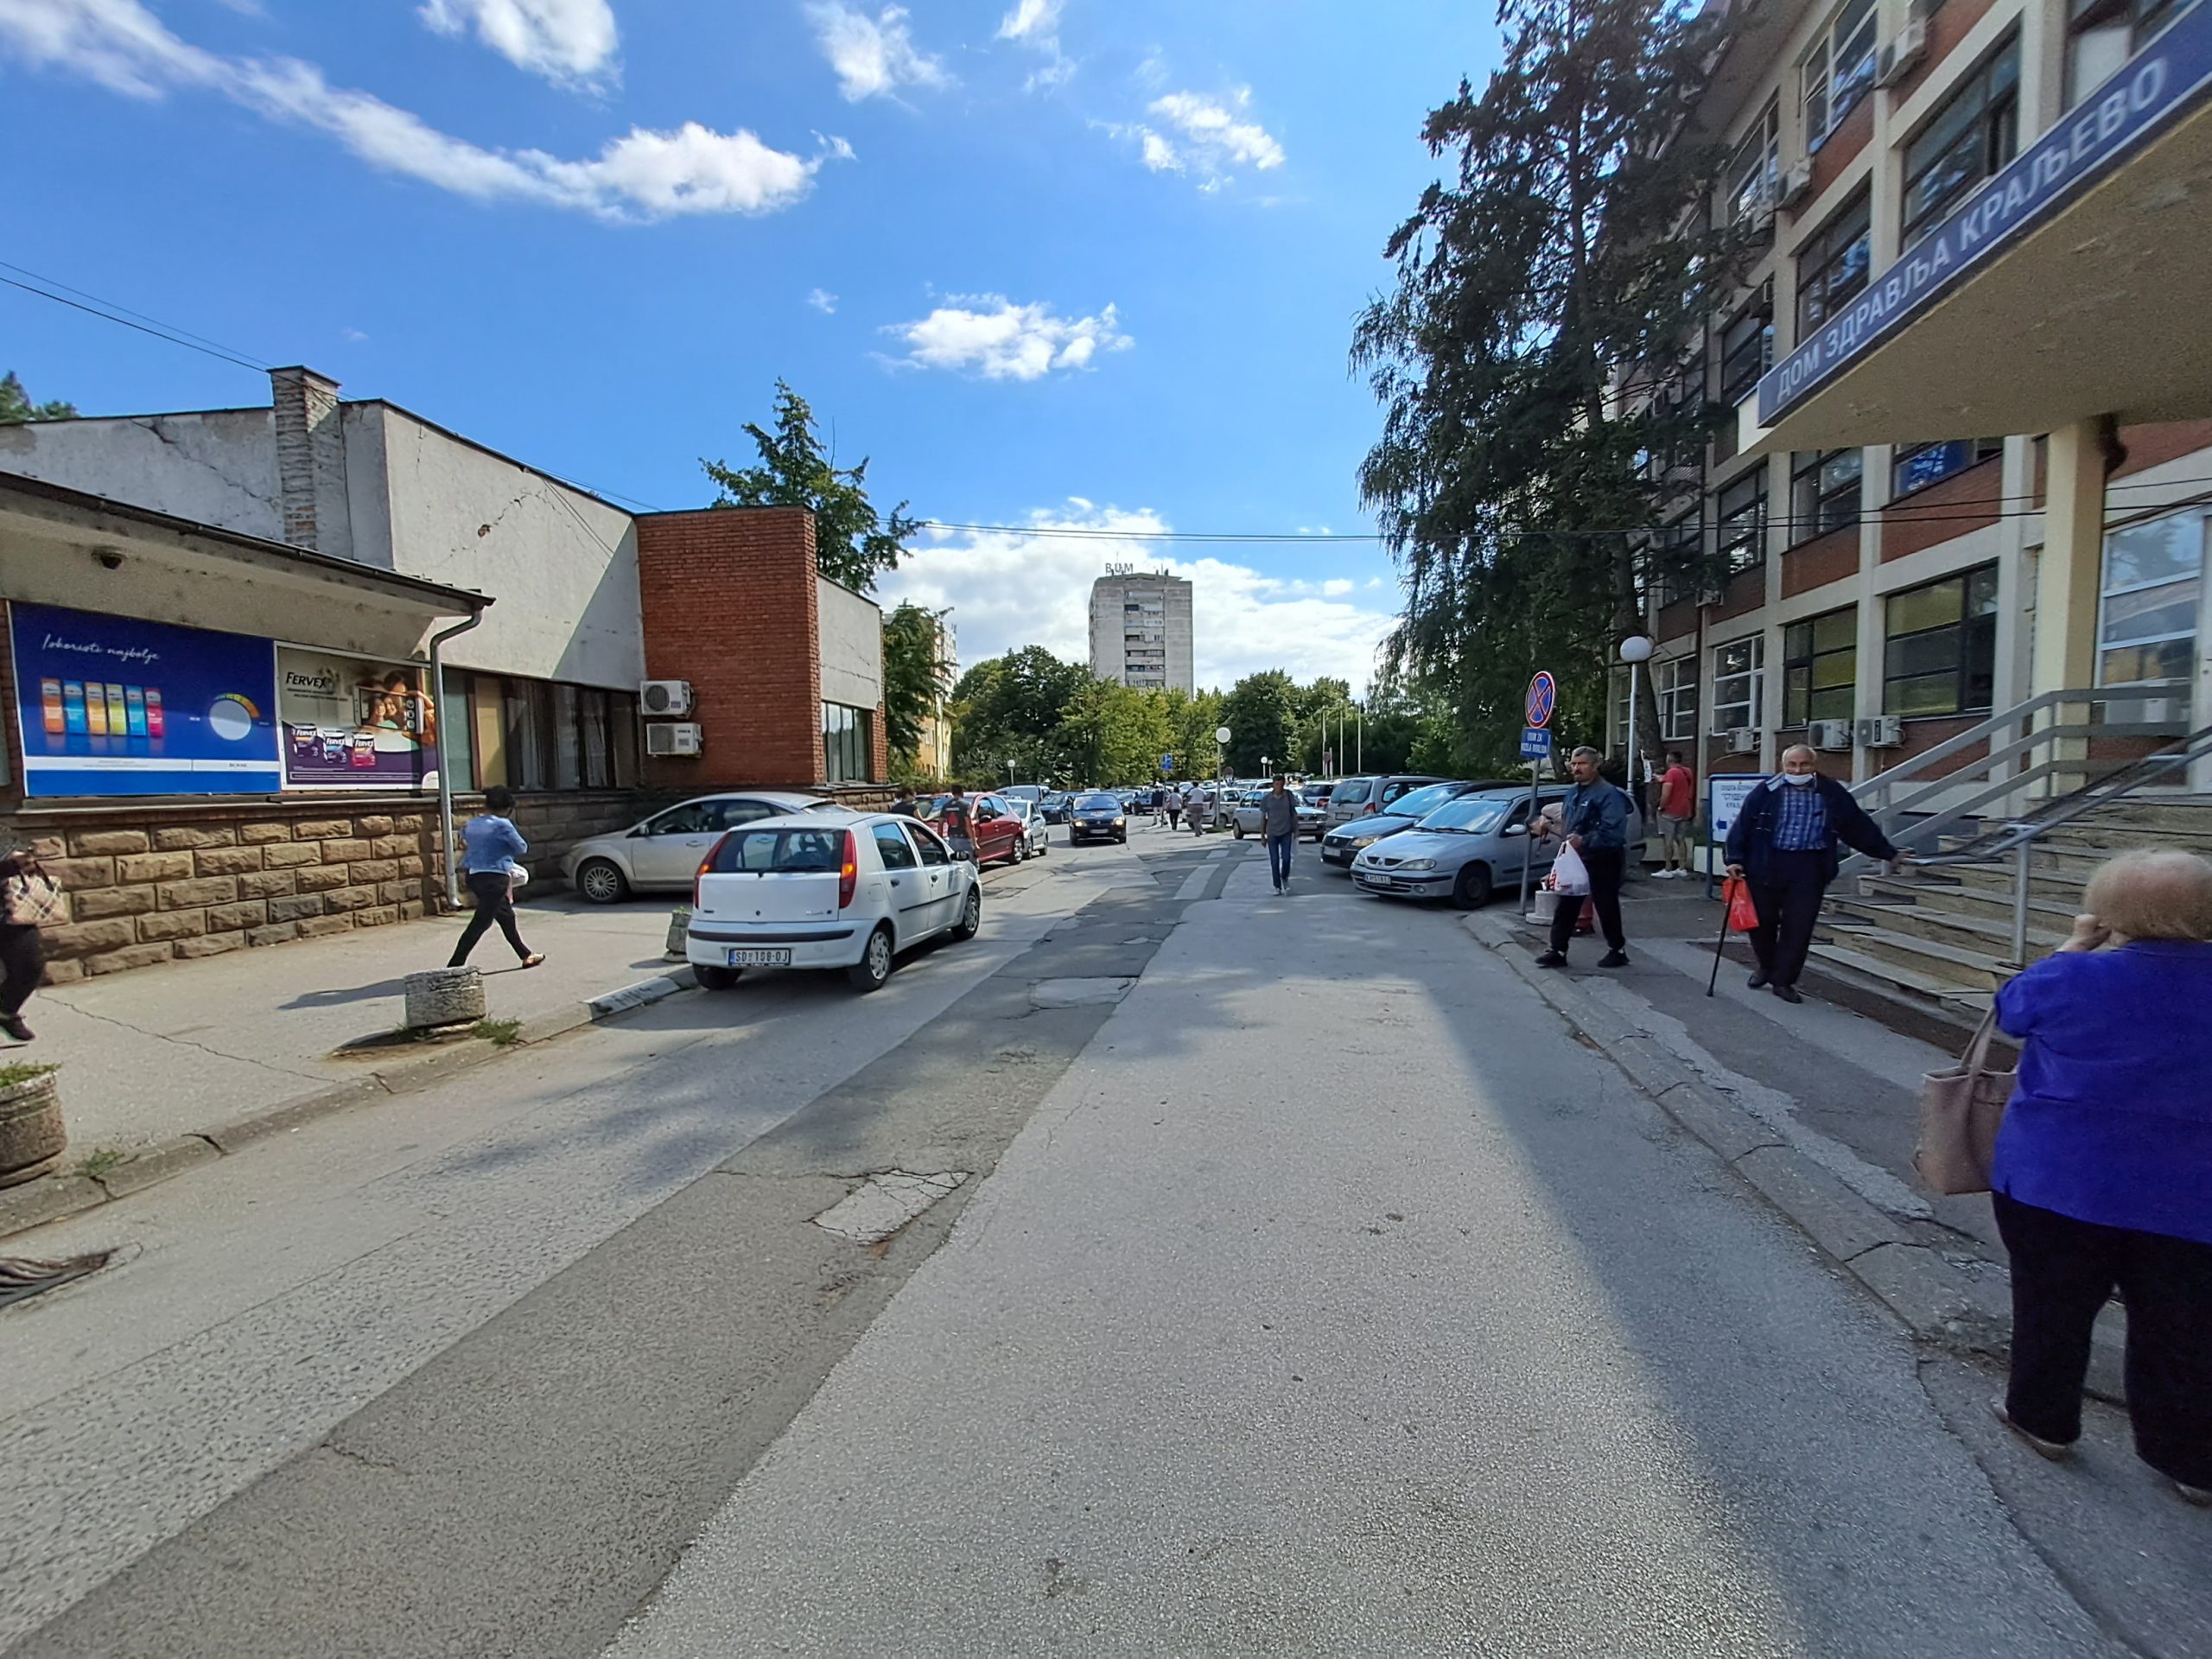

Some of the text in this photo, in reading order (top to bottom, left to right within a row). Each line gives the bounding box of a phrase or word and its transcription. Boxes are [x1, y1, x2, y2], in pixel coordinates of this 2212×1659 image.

[1777, 57, 2170, 403] ДОМ ЗДРАВЉА КРАЉЕВО
[285, 671, 327, 690] FERVEX
